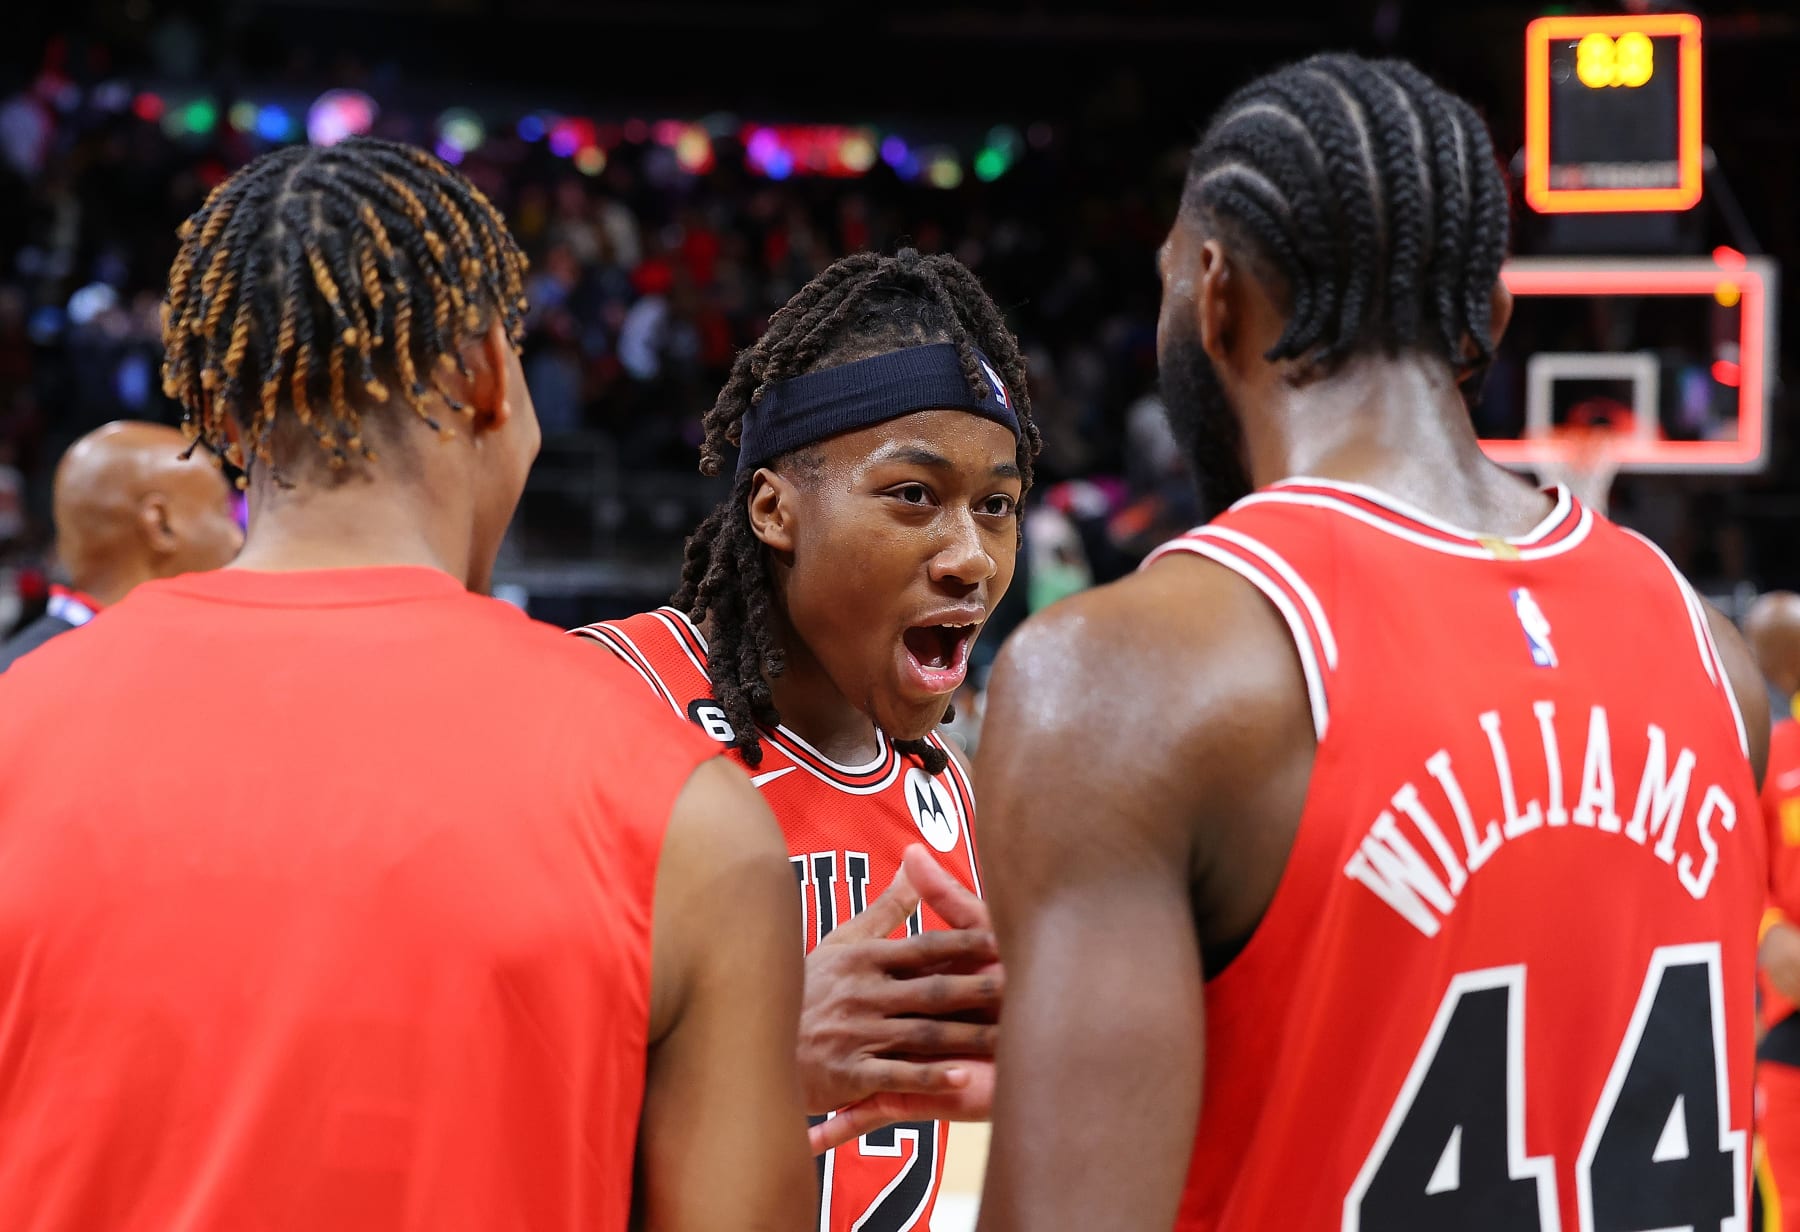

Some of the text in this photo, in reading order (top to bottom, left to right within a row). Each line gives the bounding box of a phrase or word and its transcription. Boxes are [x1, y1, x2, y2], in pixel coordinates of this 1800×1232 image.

[697, 706, 736, 742] 6
[1343, 700, 1737, 939] WILLIAMS
[1341, 941, 1748, 1232] 44
